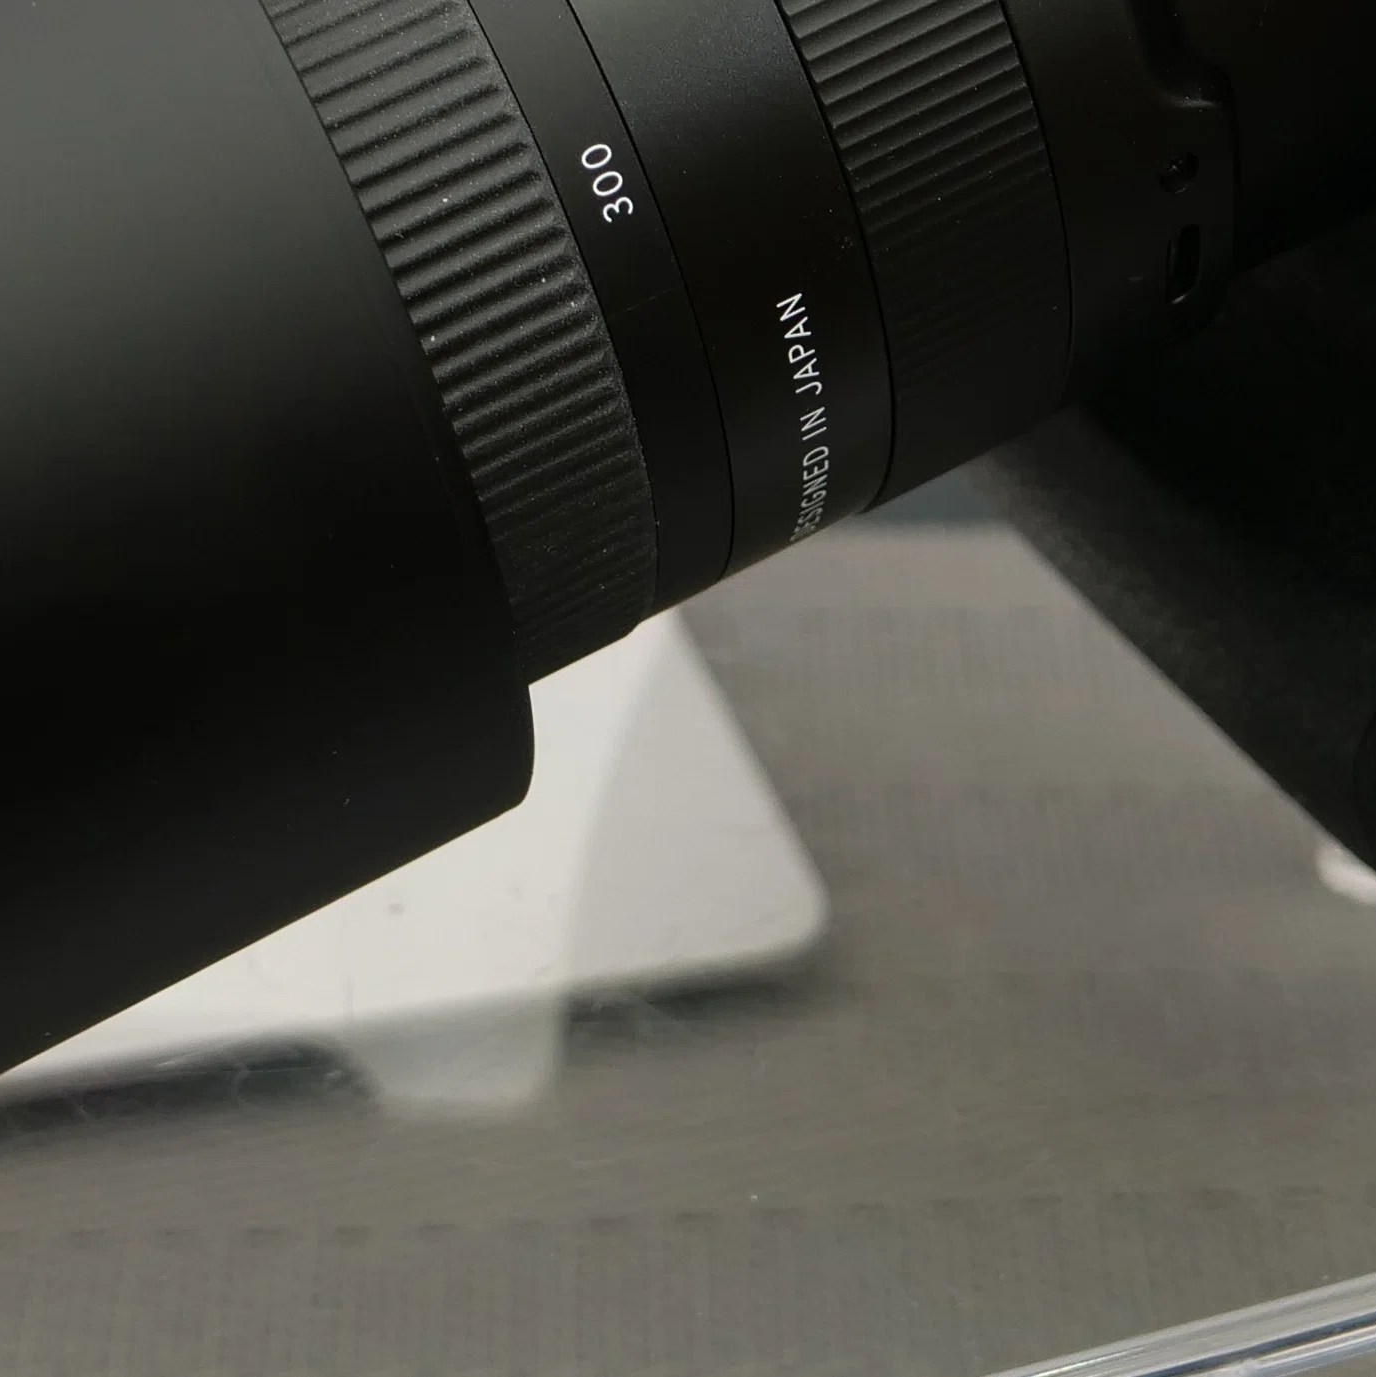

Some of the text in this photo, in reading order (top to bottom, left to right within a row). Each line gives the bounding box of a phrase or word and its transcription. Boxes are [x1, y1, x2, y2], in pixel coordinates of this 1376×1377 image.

[581, 143, 634, 223] 300
[776, 292, 823, 395] JAPAN
[799, 406, 827, 441] IN
